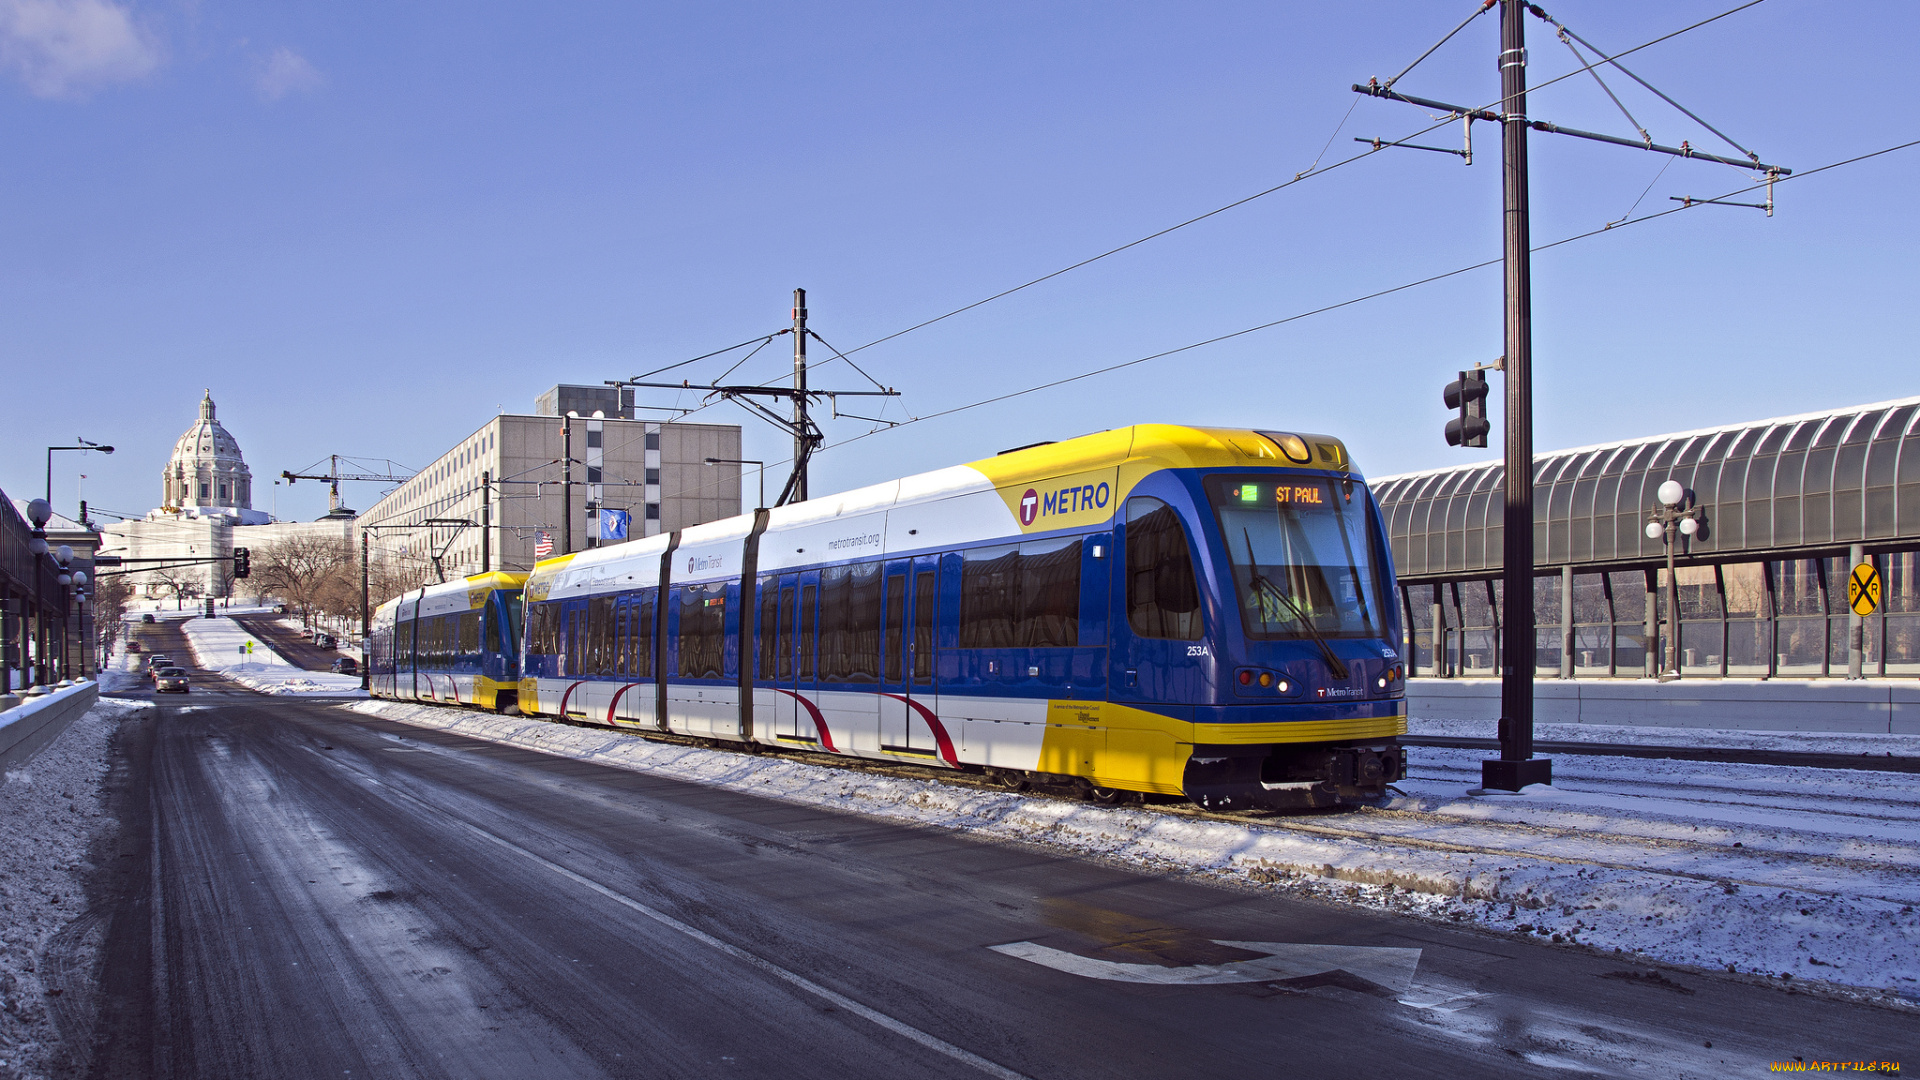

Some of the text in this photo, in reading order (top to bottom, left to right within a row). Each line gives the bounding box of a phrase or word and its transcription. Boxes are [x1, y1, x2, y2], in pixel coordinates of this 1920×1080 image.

[1042, 481, 1110, 517] METRO
[1276, 486, 1323, 504] ST PAUL
[828, 532, 880, 551] metrotransit.org
[1187, 646, 1209, 656] 253A
